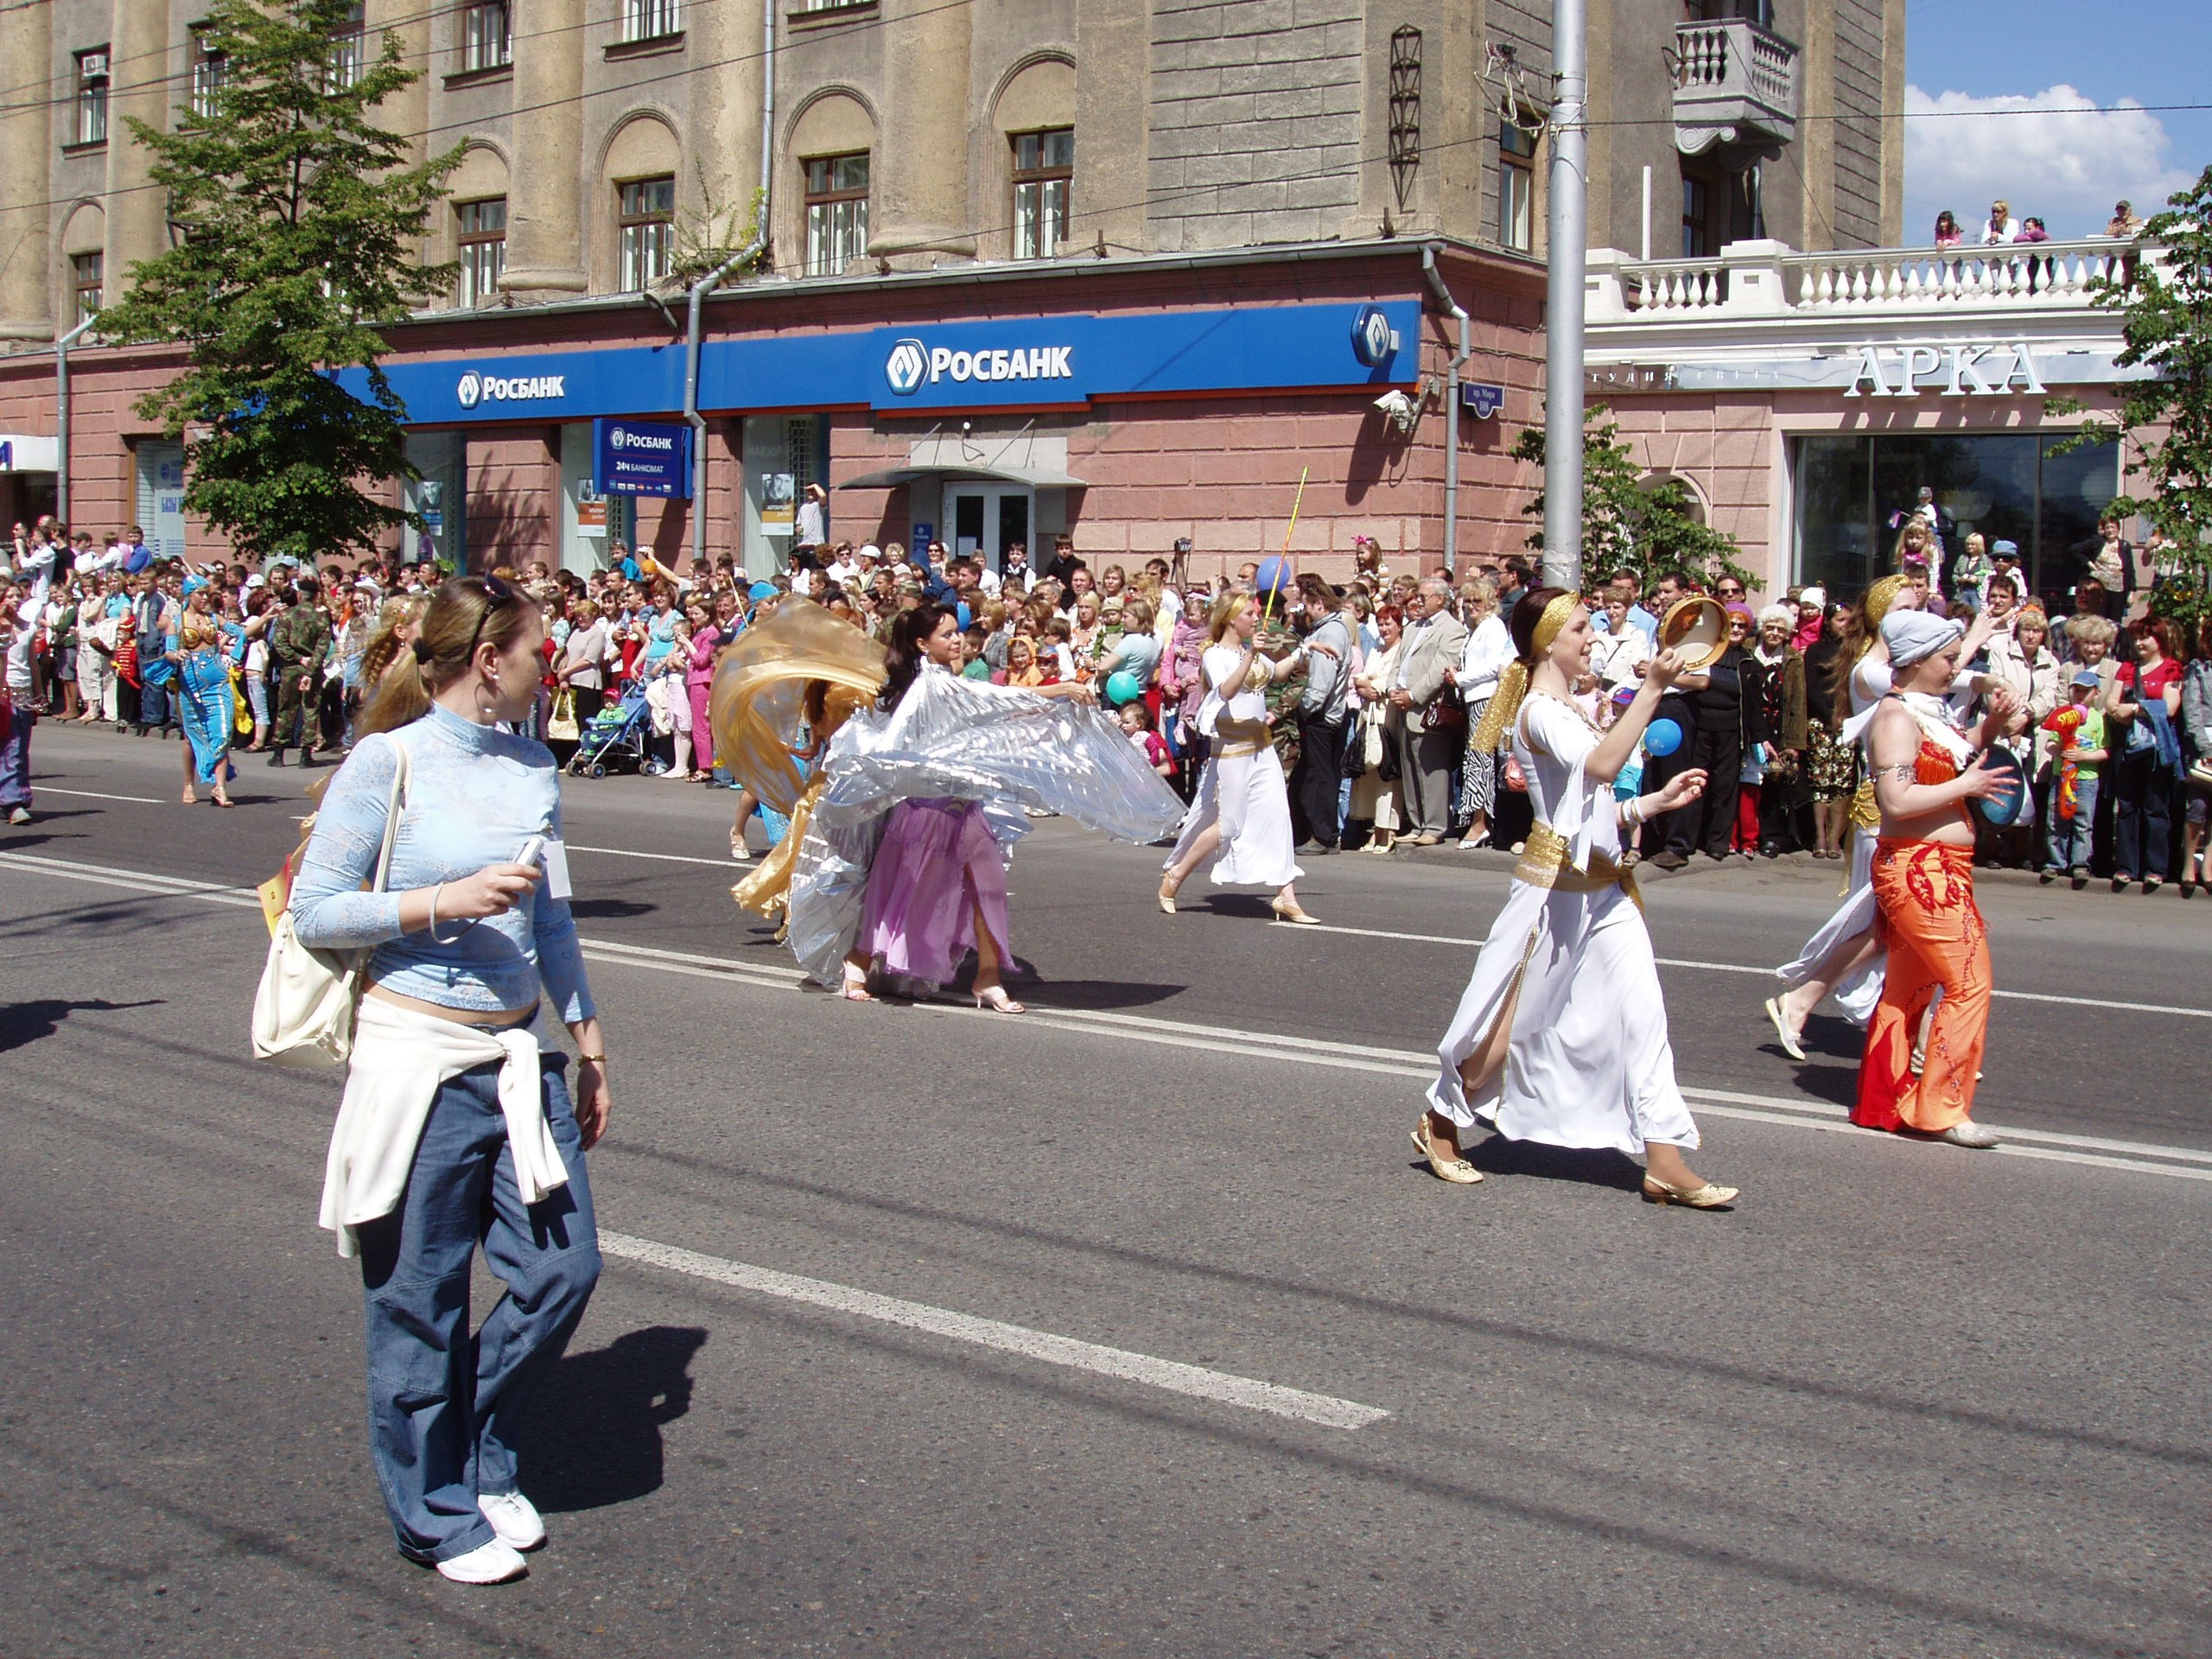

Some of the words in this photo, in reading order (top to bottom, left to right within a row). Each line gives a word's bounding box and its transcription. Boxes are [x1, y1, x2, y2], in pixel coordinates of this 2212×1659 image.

[931, 346, 1072, 384] РОСБАНК
[1843, 343, 2047, 397] АРКА
[482, 376, 564, 401] РОСБАНК
[1591, 372, 1672, 385] ТУДИЯ
[626, 433, 672, 449] РОСБАНК
[631, 463, 664, 474] БАНКОМАТ
